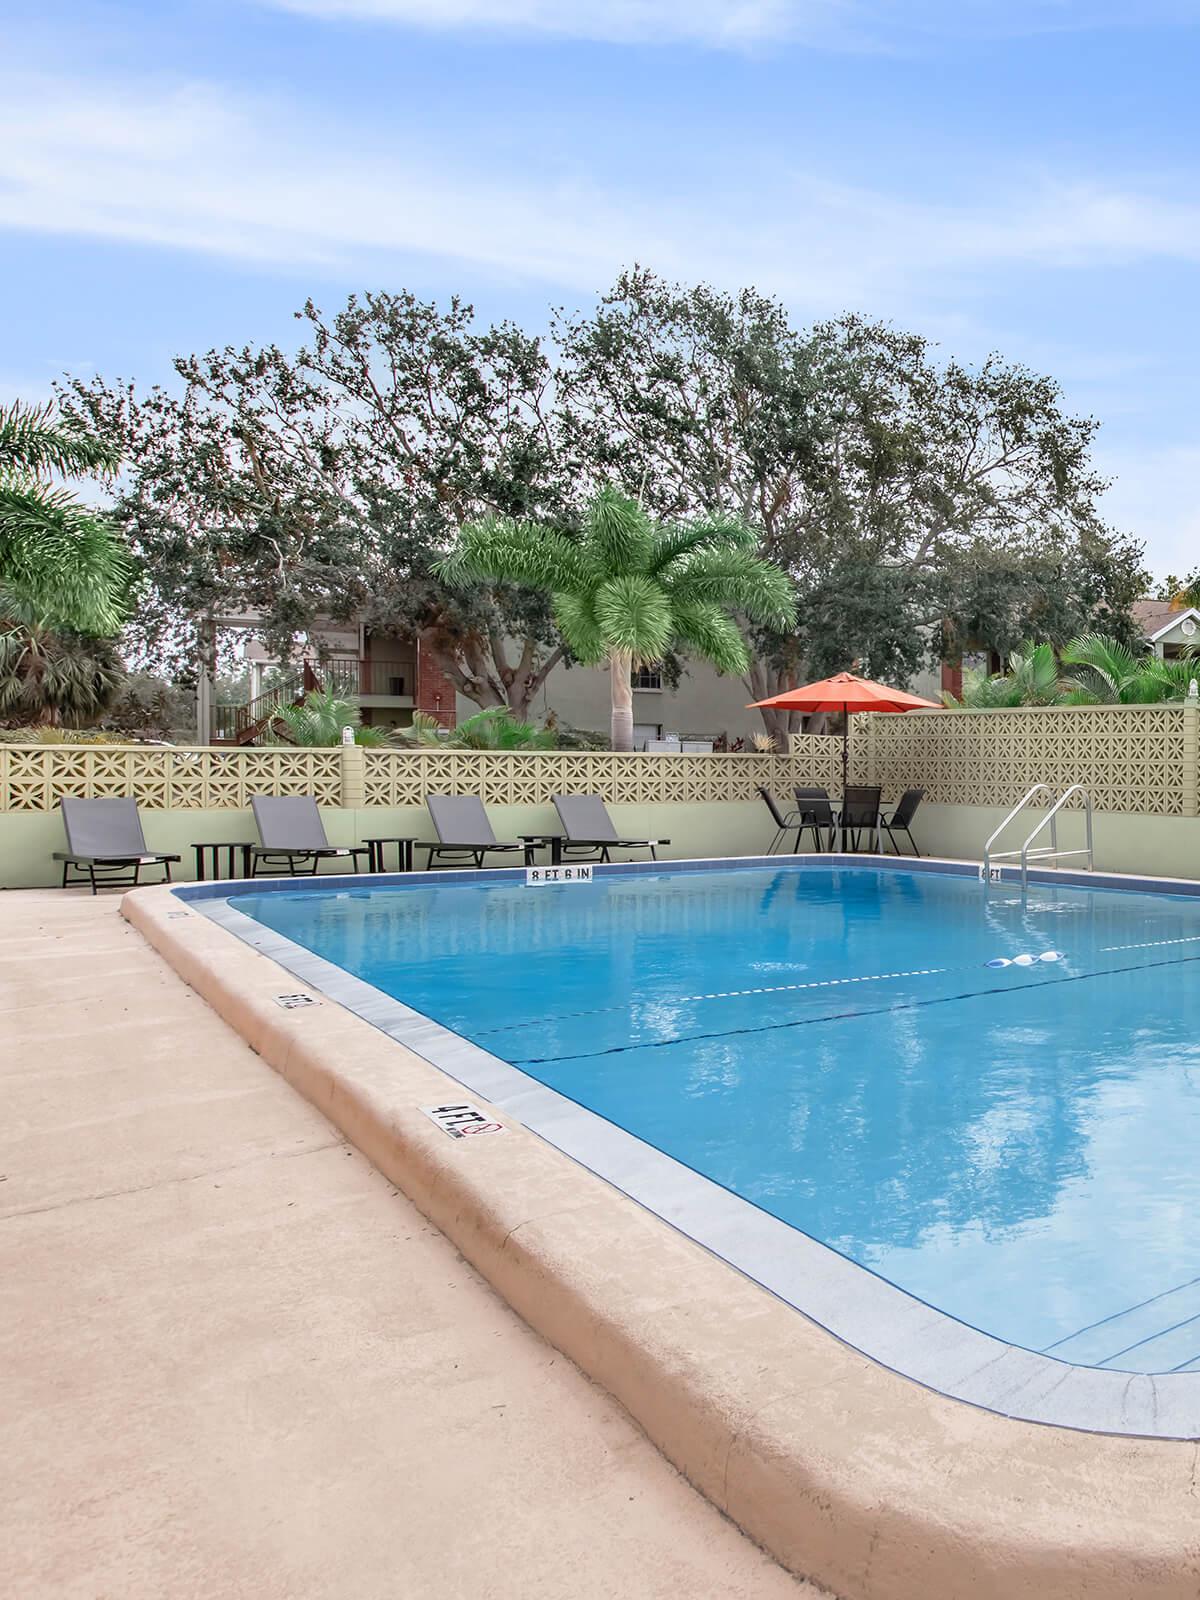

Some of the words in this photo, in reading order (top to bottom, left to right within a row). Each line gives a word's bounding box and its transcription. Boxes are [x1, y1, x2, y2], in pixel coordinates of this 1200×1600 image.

[532, 870, 539, 880] 8
[577, 868, 589, 879] IN
[991, 869, 1000, 880] FT
[431, 1105, 469, 1113] 4
[438, 1111, 487, 1126] FT
